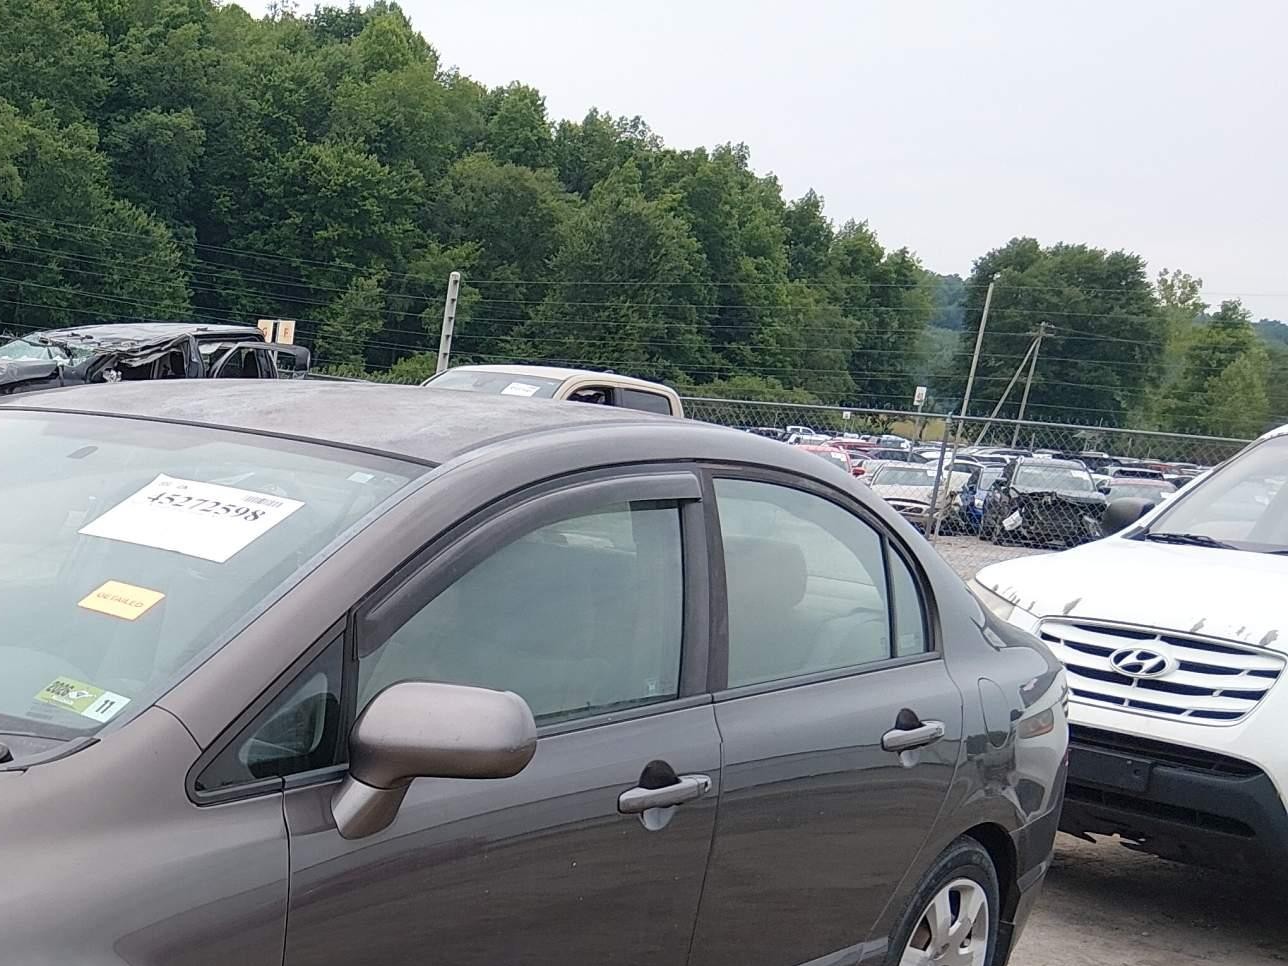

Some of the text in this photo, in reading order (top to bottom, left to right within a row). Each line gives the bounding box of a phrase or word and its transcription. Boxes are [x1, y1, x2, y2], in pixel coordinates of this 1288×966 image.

[284, 328, 289, 337] F
[147, 492, 266, 523] 45272598
[95, 699, 116, 714] 11
